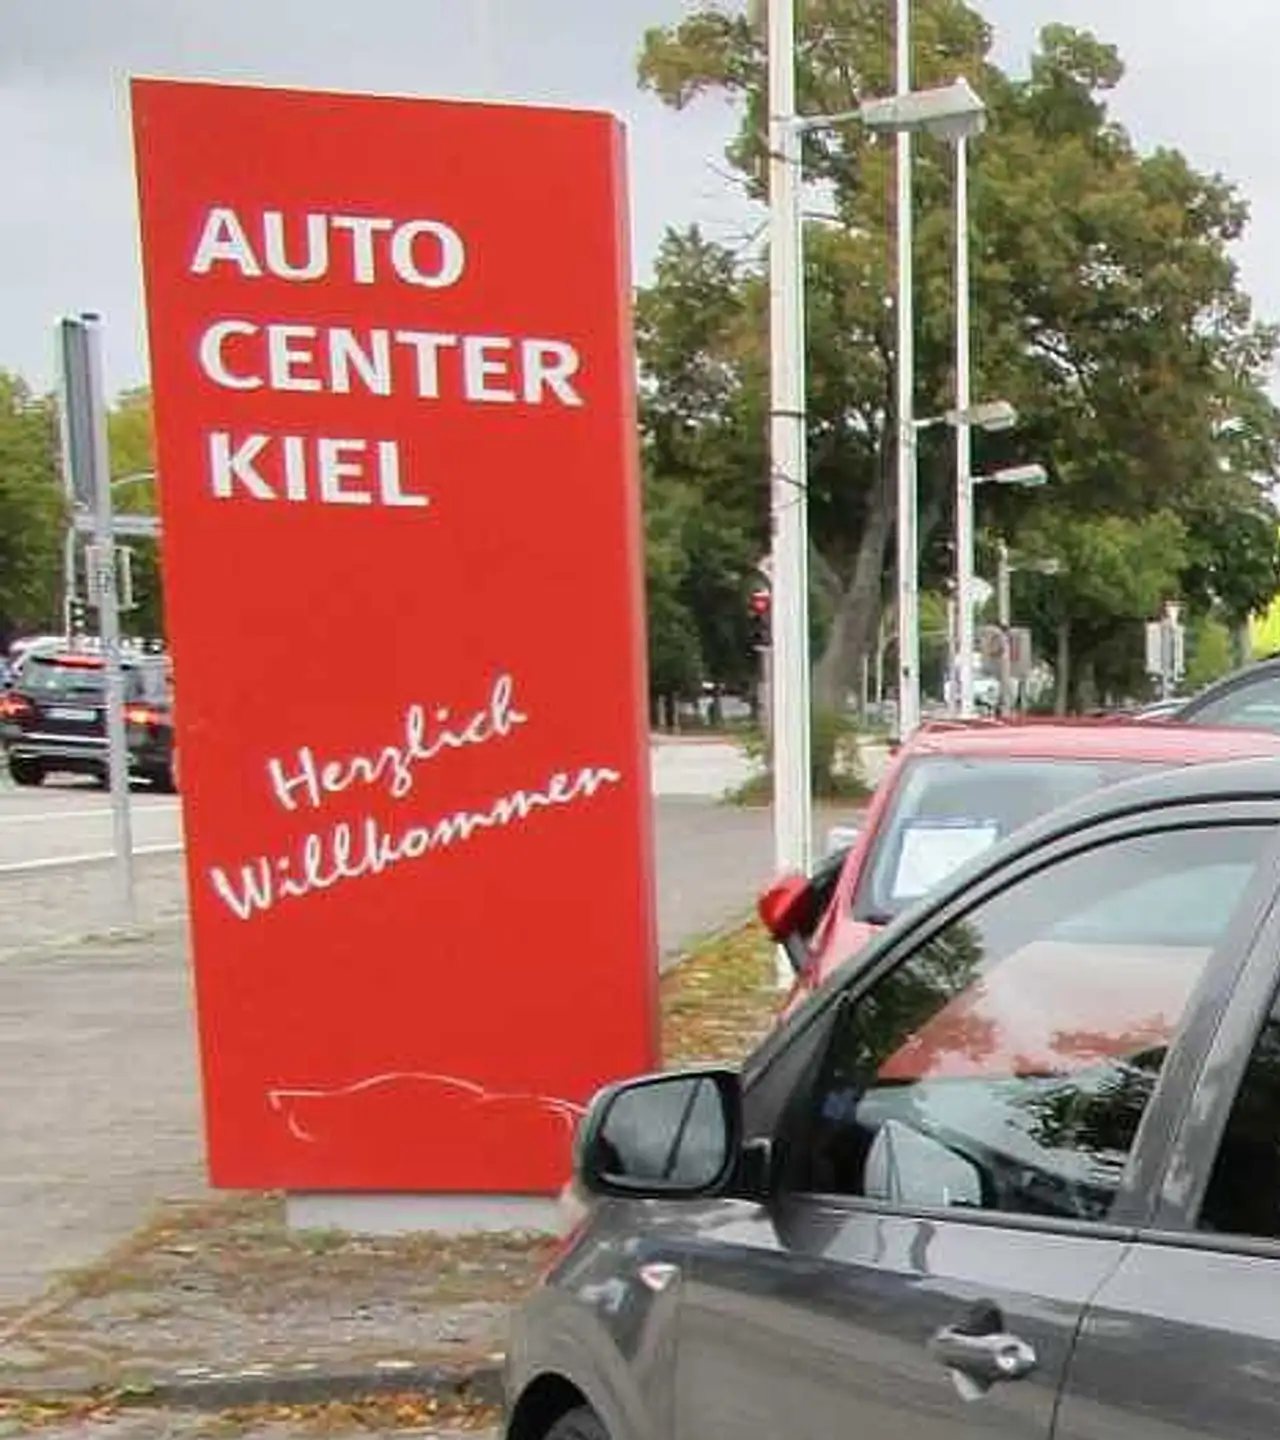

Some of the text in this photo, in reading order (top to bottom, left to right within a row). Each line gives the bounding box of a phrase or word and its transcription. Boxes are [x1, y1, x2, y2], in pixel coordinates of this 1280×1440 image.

[190, 207, 466, 288] AUTO
[198, 319, 585, 406] CENTER
[210, 431, 431, 507] KIEL
[267, 673, 529, 811] Herzlich
[209, 763, 624, 921] Willkommen
